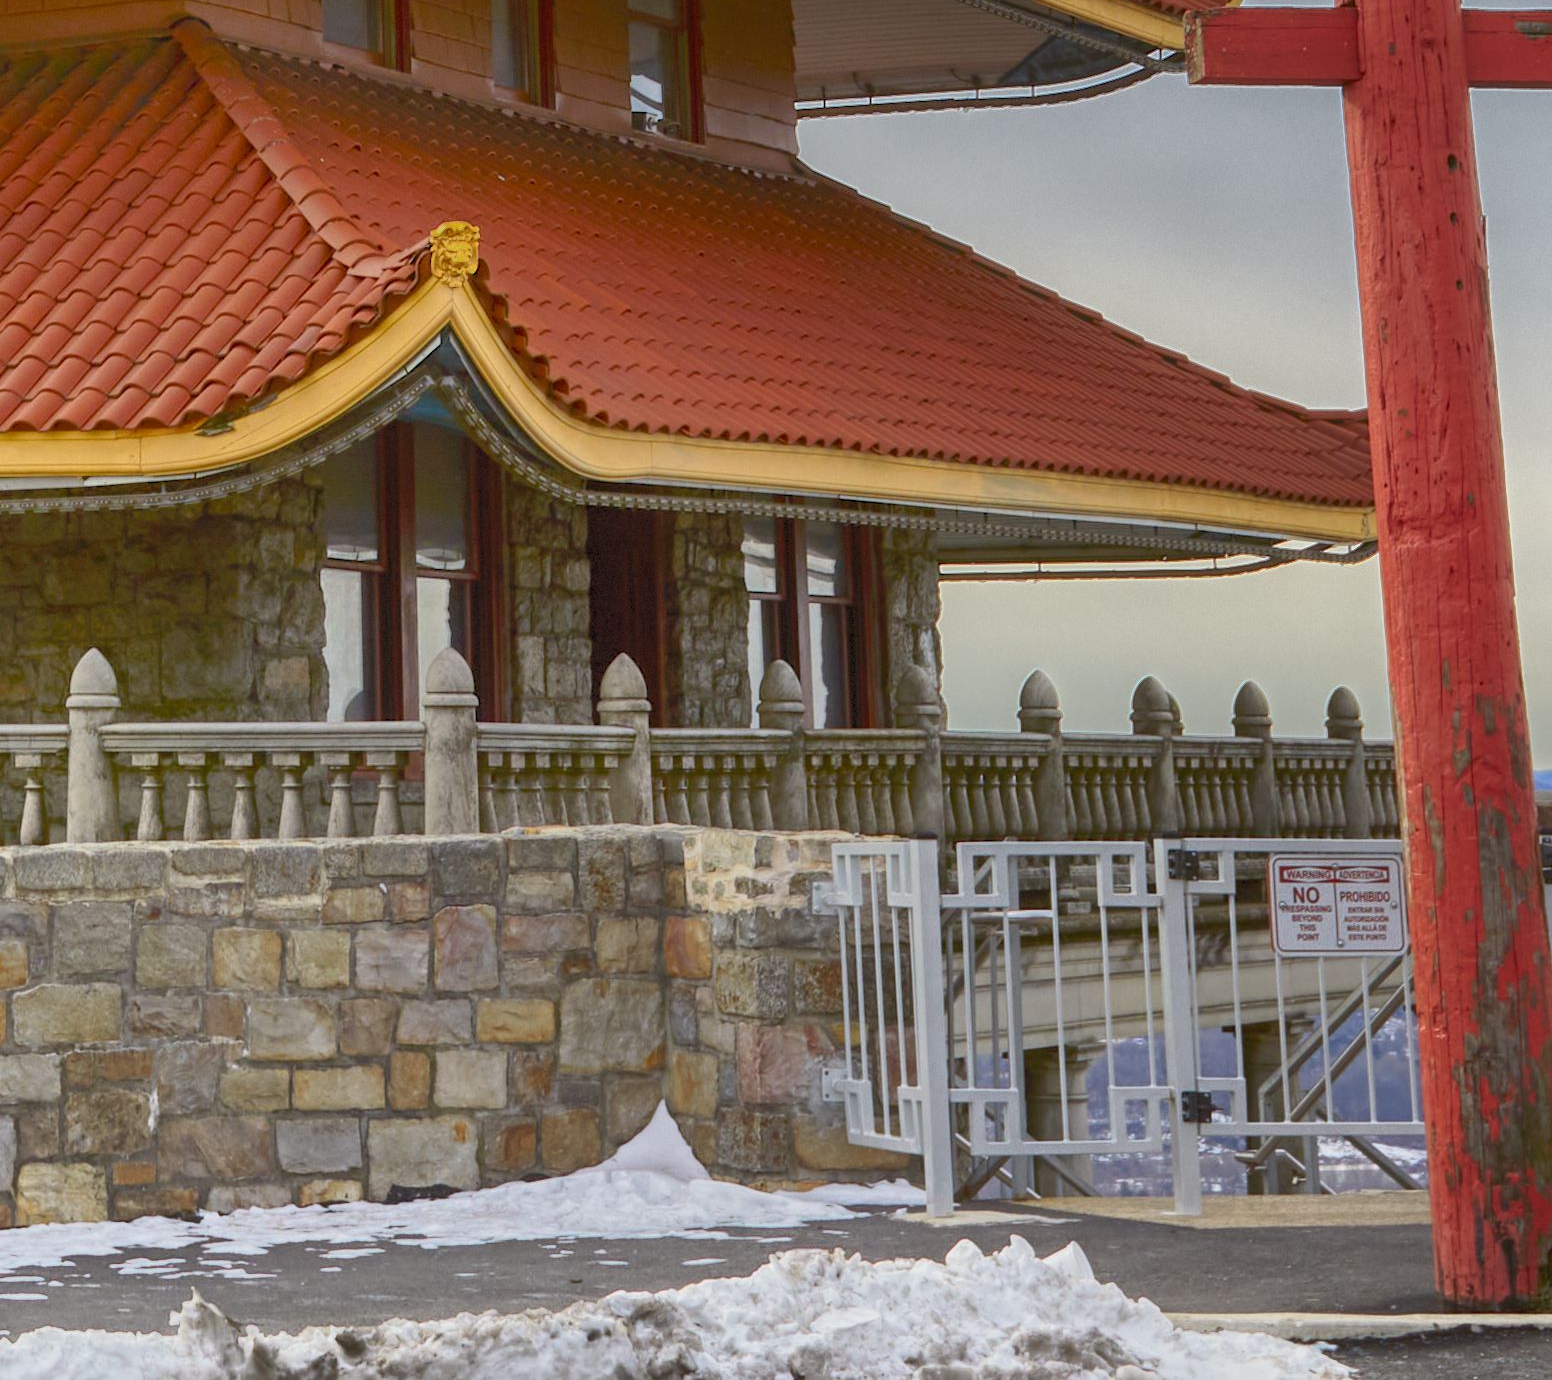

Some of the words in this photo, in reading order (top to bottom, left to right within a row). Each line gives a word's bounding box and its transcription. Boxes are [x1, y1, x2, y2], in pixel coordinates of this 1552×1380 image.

[1287, 870, 1332, 879] WARNING
[1339, 870, 1385, 880] ADVERTENCIA
[1293, 886, 1320, 904] NO
[1340, 891, 1391, 902] PROHIBIDO
[1297, 933, 1320, 941] POINT
